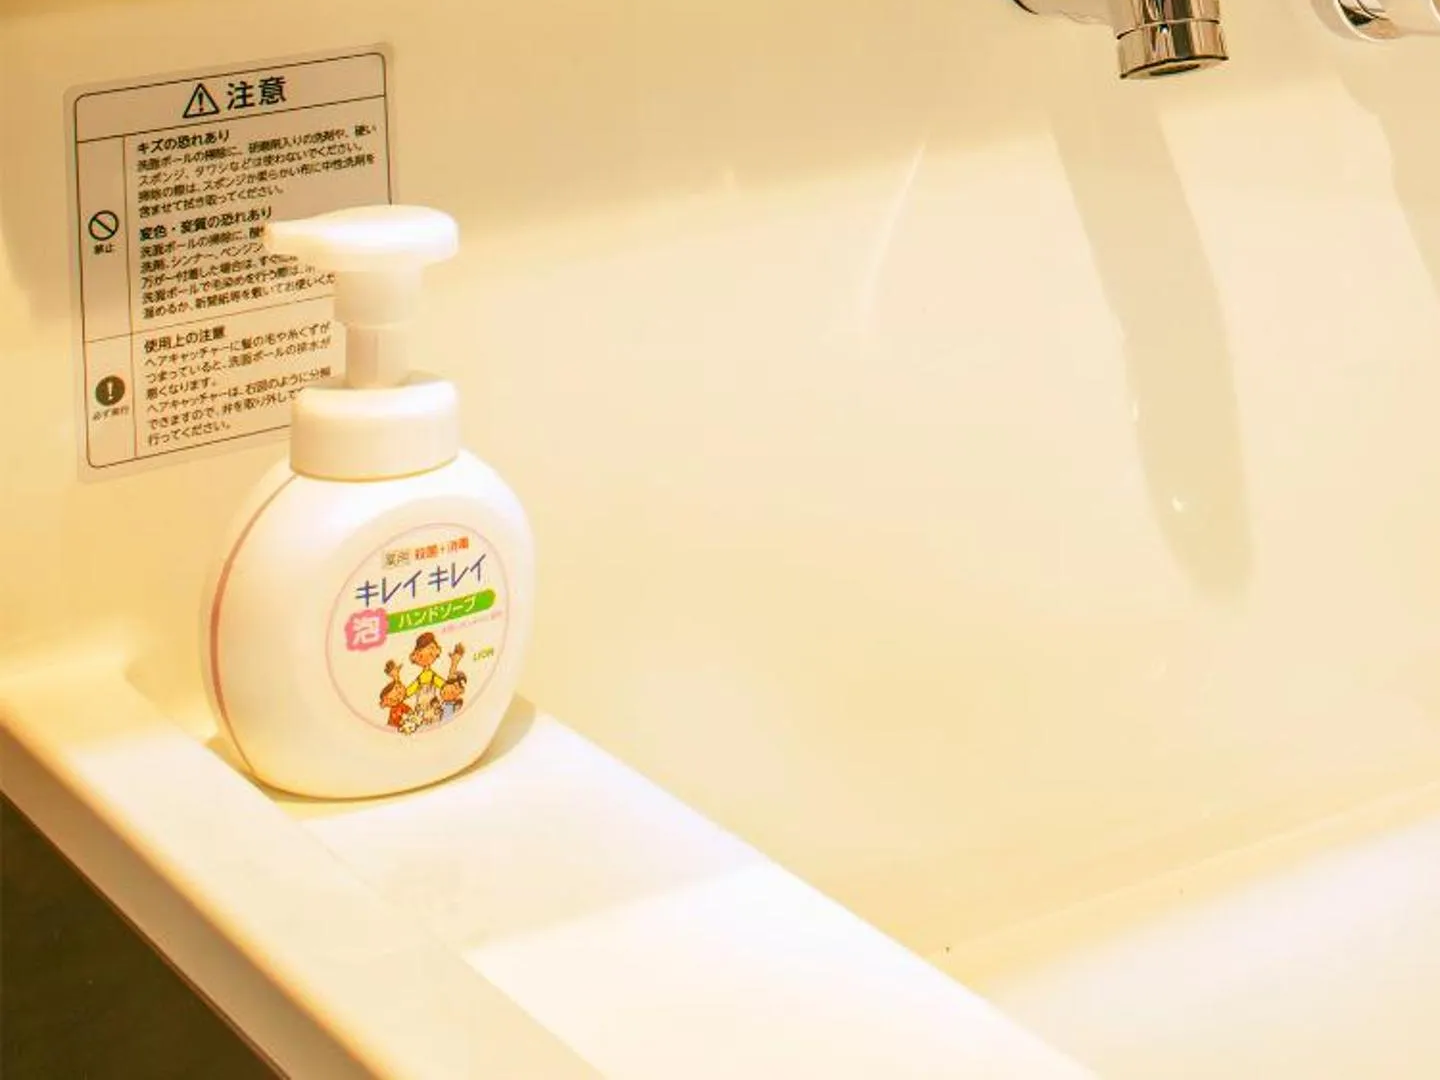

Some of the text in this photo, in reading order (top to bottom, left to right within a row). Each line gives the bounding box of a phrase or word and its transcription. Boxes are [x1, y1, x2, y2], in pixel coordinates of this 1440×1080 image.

[226, 75, 287, 110] 注意
[137, 128, 229, 156] キズの恐れあり
[139, 206, 272, 241] 変色・変質の恐れあり
[144, 325, 226, 353] 使用上の注意
[399, 596, 478, 628] ハンドソープ
